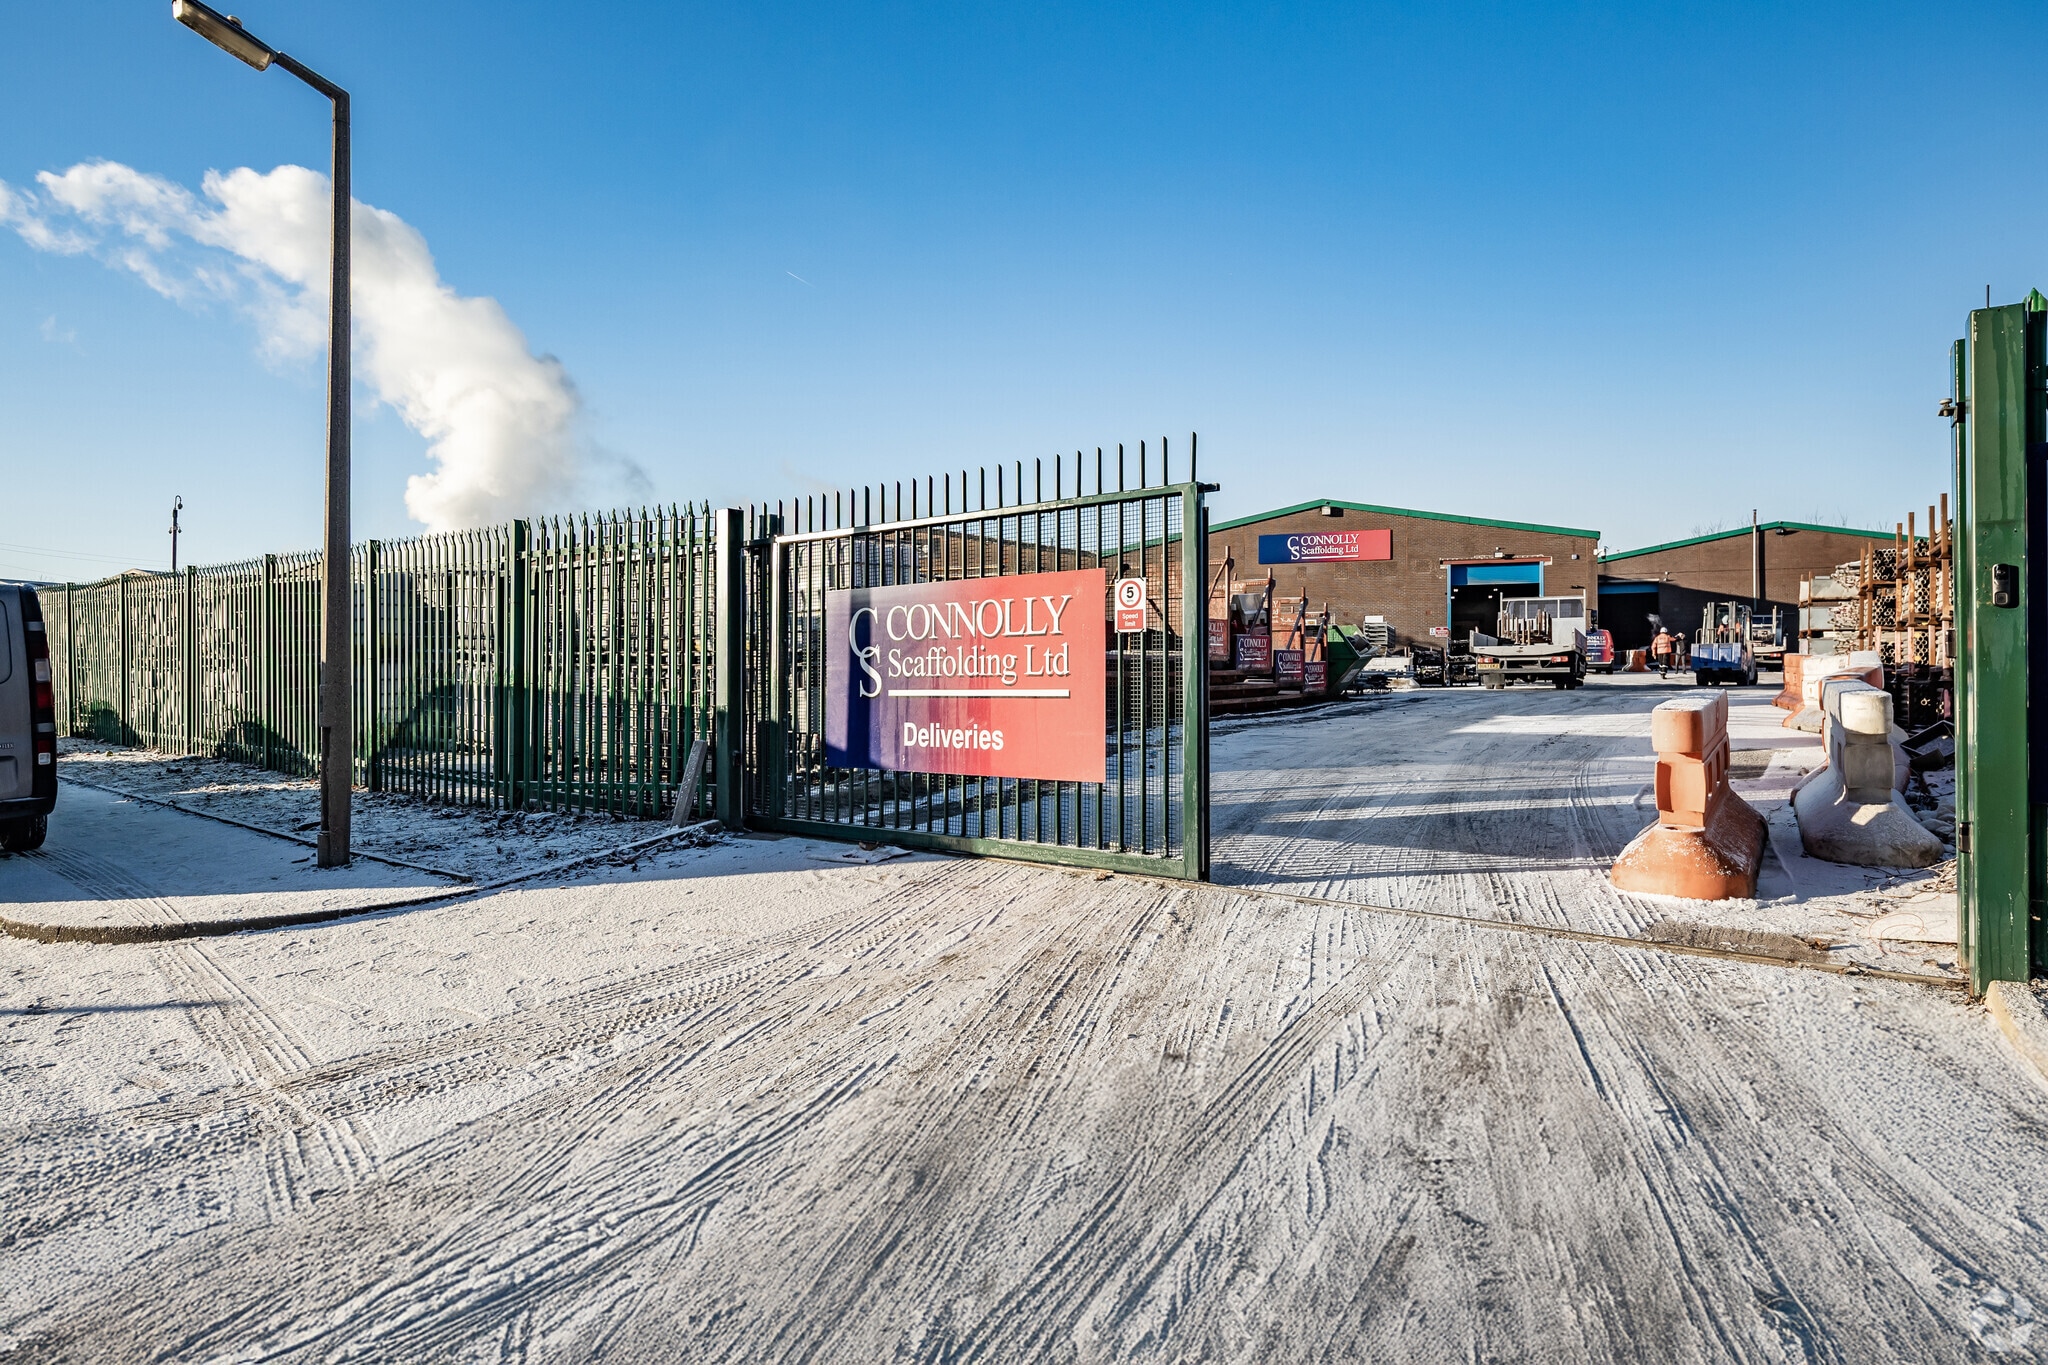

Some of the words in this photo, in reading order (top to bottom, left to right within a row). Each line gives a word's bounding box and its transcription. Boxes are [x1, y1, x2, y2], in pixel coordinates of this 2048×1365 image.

[1301, 533, 1359, 546] CONNOLLY
[1301, 545, 1344, 555] Scaffolding
[1345, 544, 1359, 553] Ltd
[1126, 586, 1134, 599] 5
[886, 594, 1073, 642] CONNOLLY
[1122, 612, 1139, 620] Speed
[888, 645, 1018, 686] Scaffolding
[1024, 642, 1071, 677] Ltd
[903, 722, 1004, 751] Deliveries
